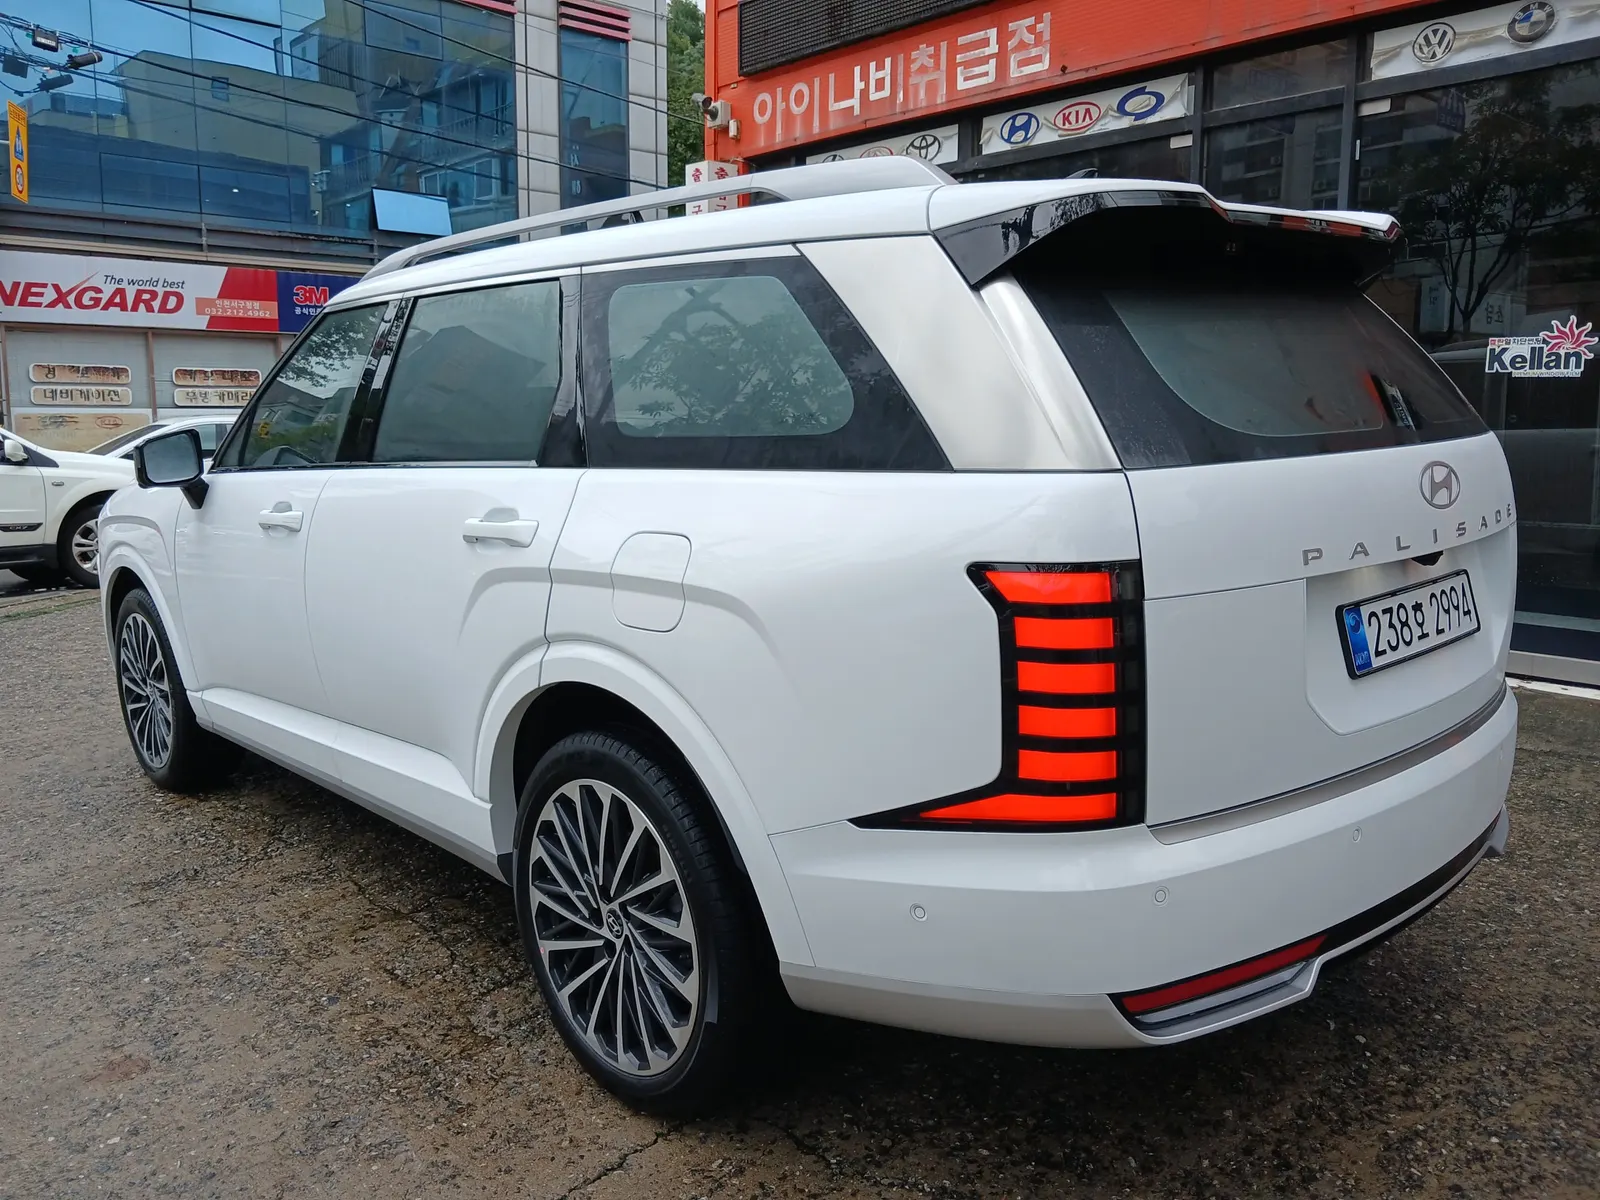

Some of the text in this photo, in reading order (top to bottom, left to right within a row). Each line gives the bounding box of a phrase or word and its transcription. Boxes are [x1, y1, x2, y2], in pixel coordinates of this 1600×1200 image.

[1061, 105, 1095, 127] KIA
[103, 274, 186, 289] The world best
[0, 276, 185, 314] NEXGARD
[293, 285, 329, 306] 3M
[1487, 346, 1583, 371] Kellan
[43, 388, 122, 402] 네비게이션
[1302, 503, 1512, 566] PALISADE
[1367, 582, 1472, 658] 238호 2994
